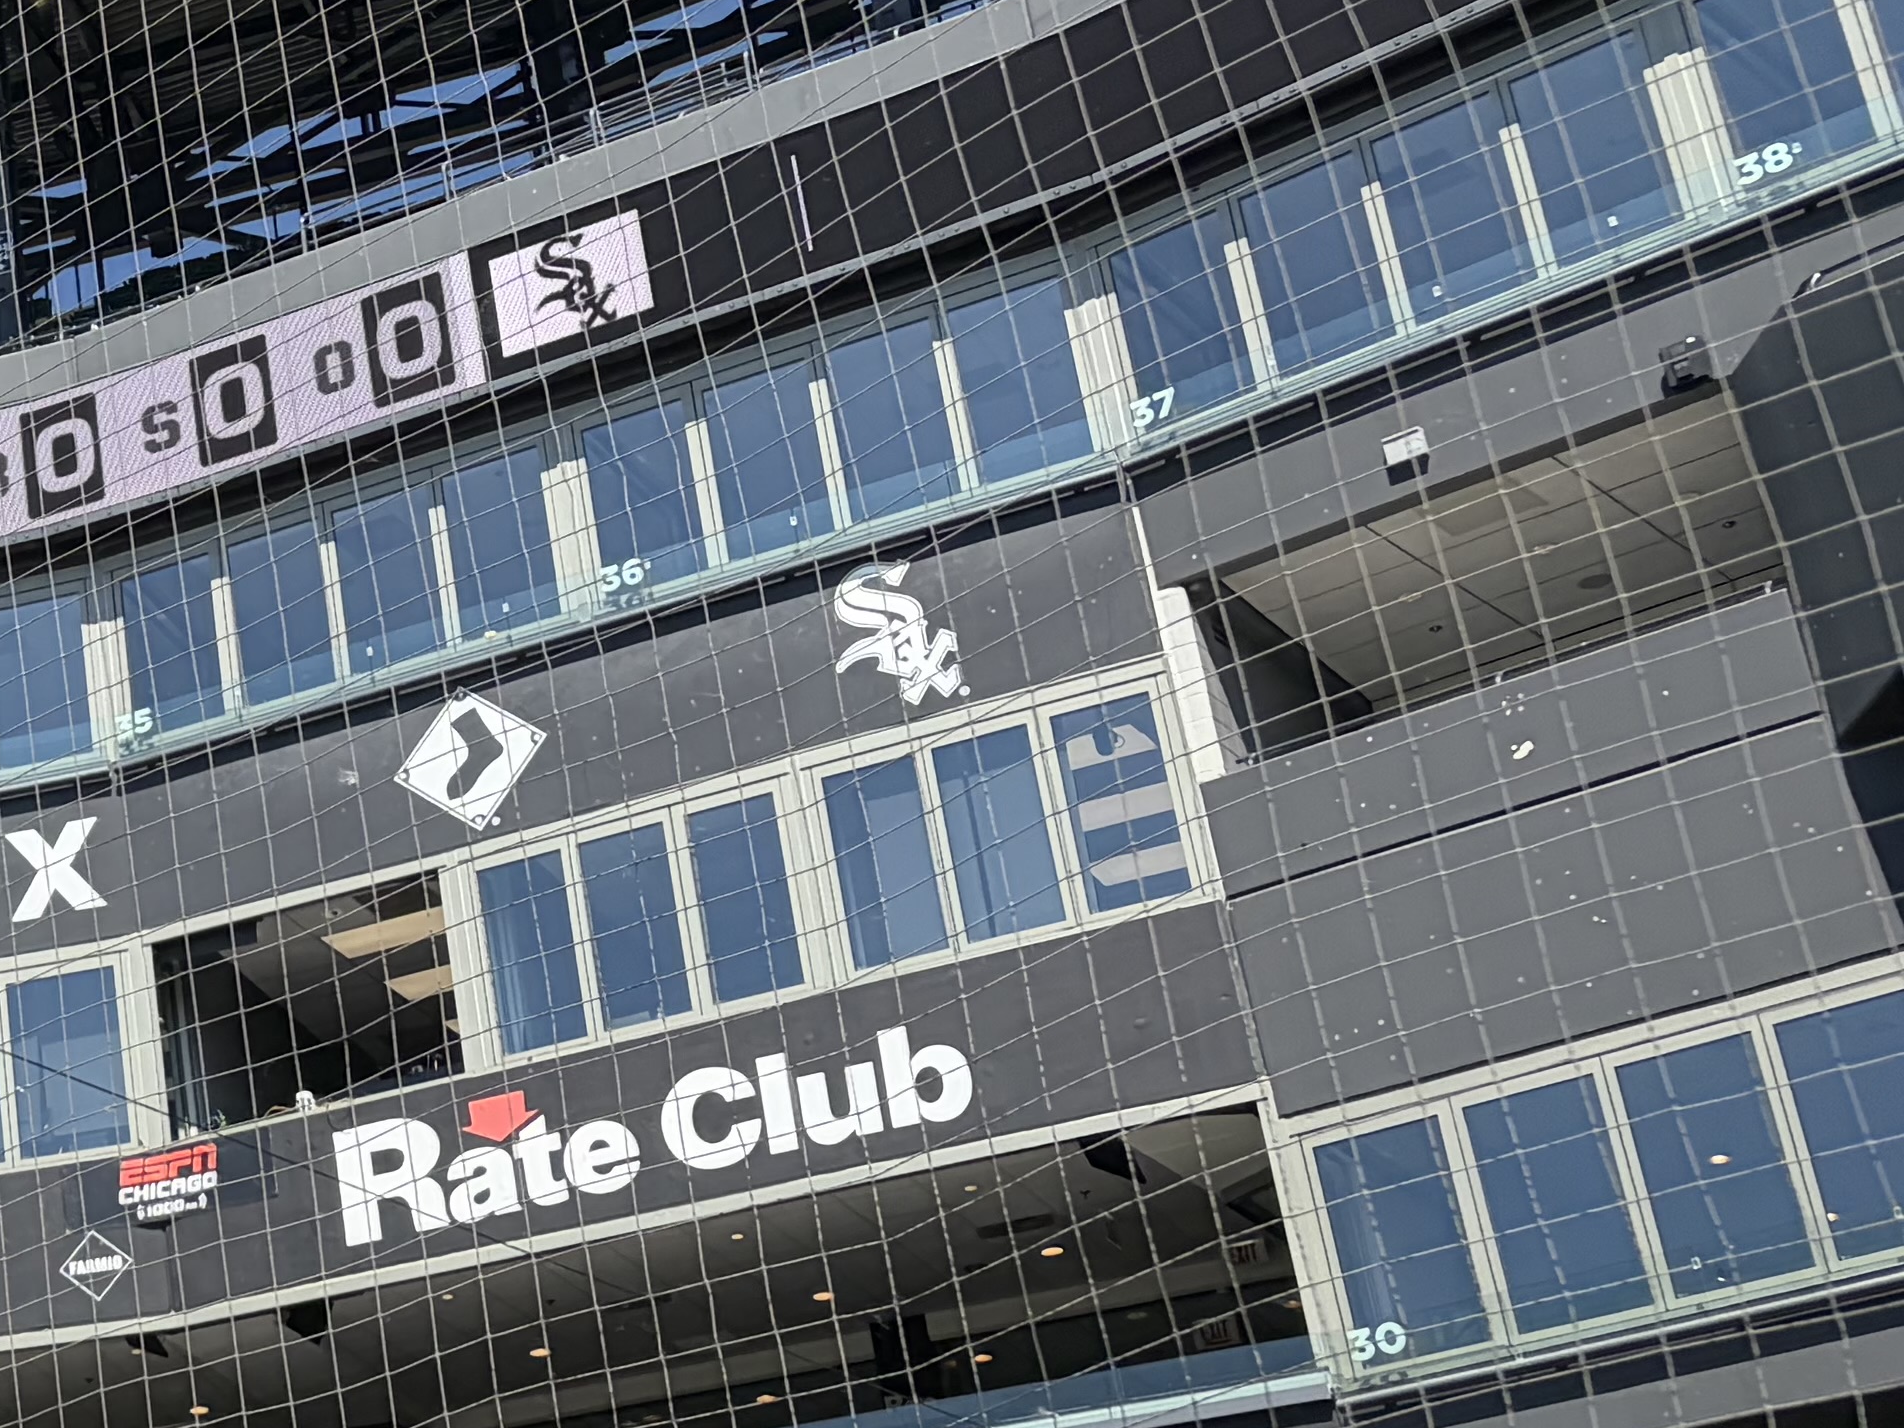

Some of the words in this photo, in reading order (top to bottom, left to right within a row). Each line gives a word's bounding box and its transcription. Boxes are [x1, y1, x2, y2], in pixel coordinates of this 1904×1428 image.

[1733, 142, 1794, 186] 38
[376, 299, 443, 379] 0
[142, 401, 181, 453] S
[201, 362, 266, 439] 0
[1129, 387, 1176, 429] 37
[33, 418, 94, 494] 0
[599, 560, 646, 591] 36
[114, 707, 155, 737] 35
[332, 1109, 641, 1247] Rate
[660, 1024, 974, 1170] Club
[119, 1142, 215, 1185] ESPN
[118, 1170, 215, 1204] CHICAGO
[1346, 1321, 1406, 1362] 30
